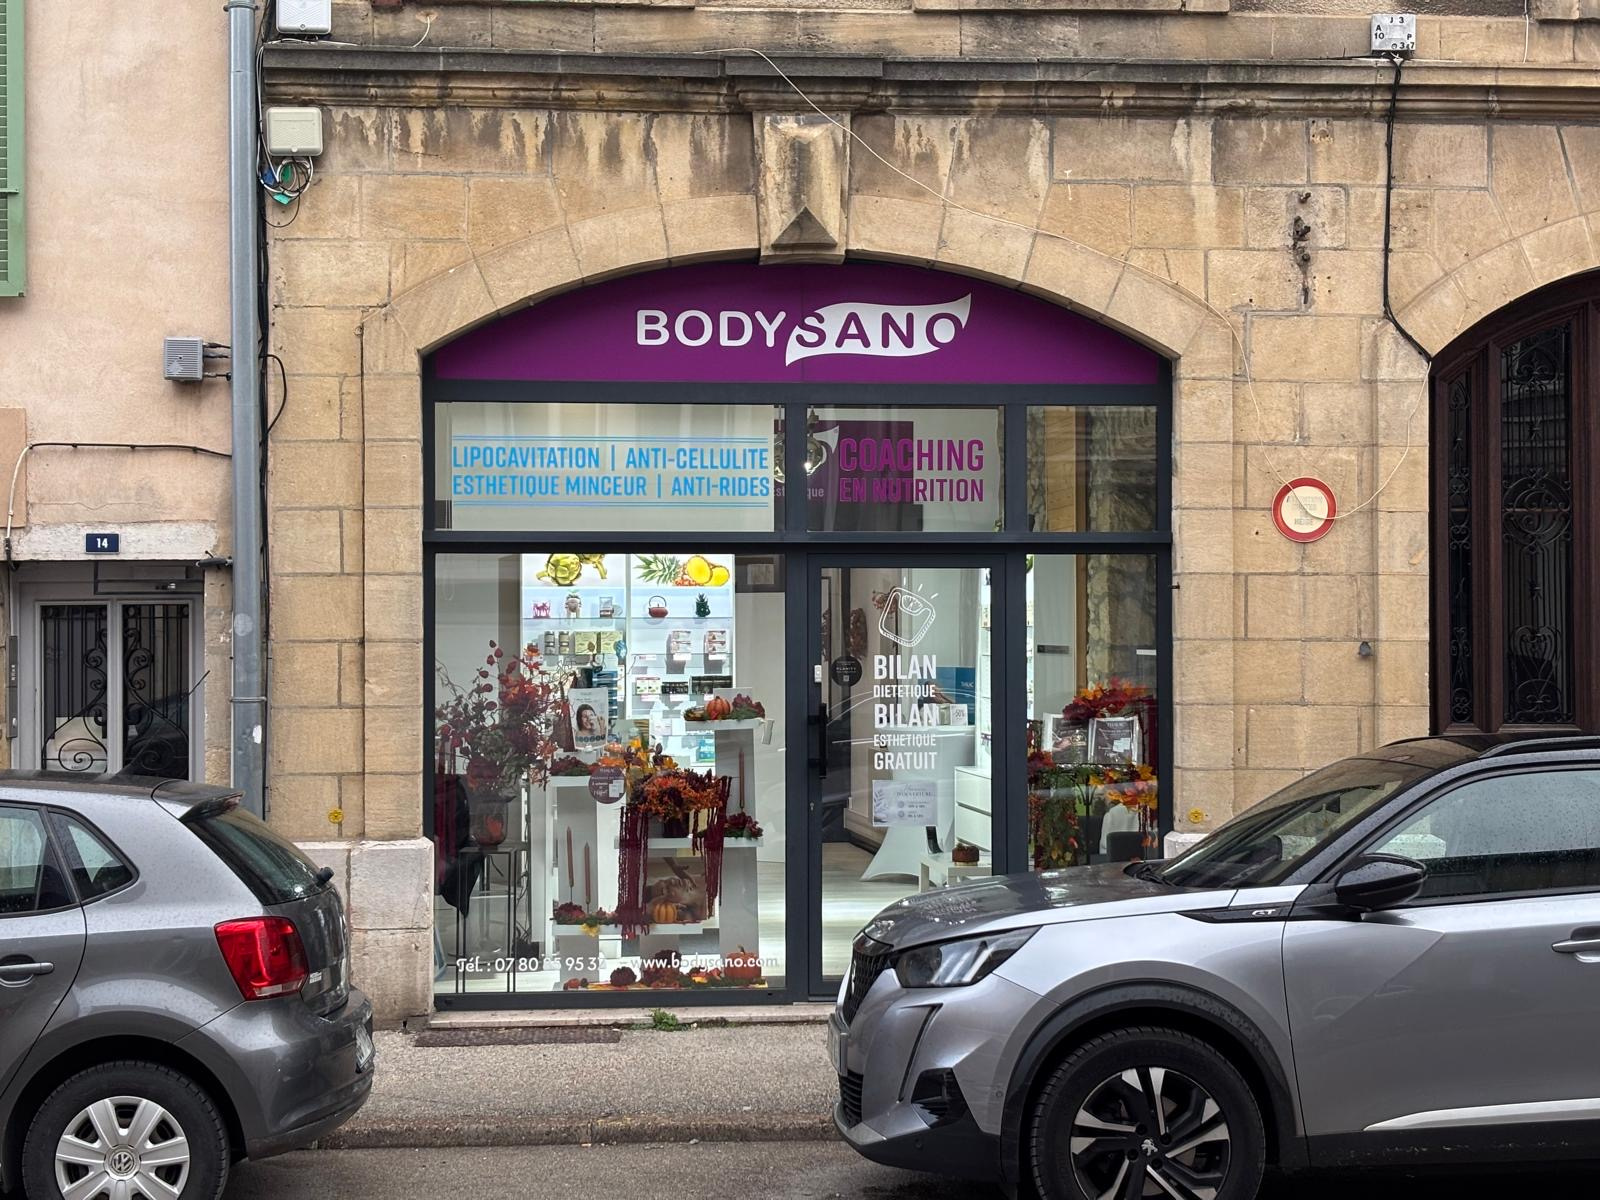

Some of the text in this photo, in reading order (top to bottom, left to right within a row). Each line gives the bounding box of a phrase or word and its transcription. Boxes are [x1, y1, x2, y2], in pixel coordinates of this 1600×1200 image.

[636, 308, 963, 349] BODYSANO
[452, 446, 600, 469] LIPOCAVITATION
[625, 447, 769, 470] ANTI-CELLULITE
[839, 438, 984, 472] COACHING
[452, 475, 560, 497] ESTHETIQUE
[566, 475, 647, 496] MINCEUR
[671, 476, 770, 497] ANTI-RIDES
[839, 478, 865, 502] EN
[870, 478, 984, 503] NUTRITION
[96, 537, 109, 549] 14
[873, 654, 937, 680] BILAN
[873, 684, 936, 698] DIETETIQUE
[873, 703, 937, 729] BILAN
[873, 733, 936, 748] ESTHETIQUE
[873, 752, 937, 770] GRATUIT
[1252, 909, 1276, 917] GT
[495, 957, 515, 972] 07
[518, 957, 539, 971] 80
[565, 957, 584, 971] 95
[630, 952, 778, 971] www.bodysano.com
